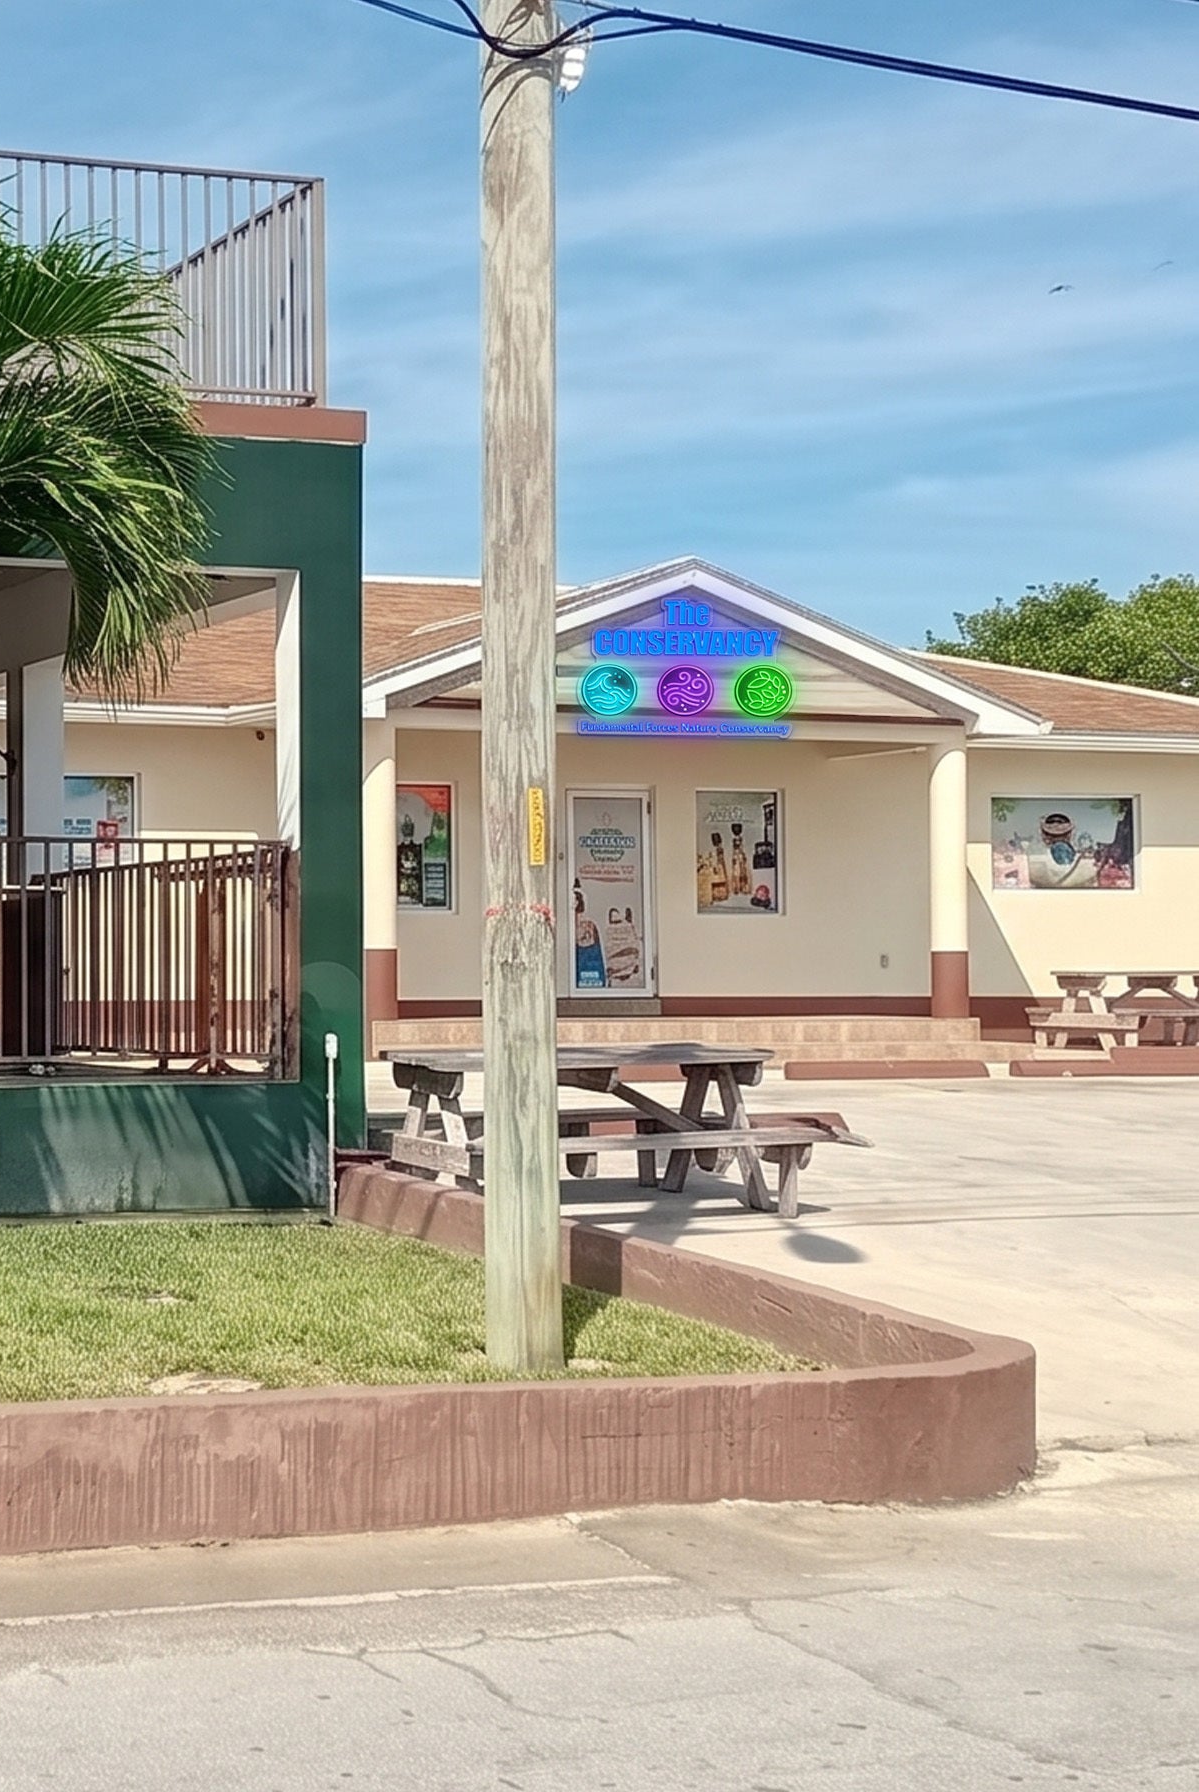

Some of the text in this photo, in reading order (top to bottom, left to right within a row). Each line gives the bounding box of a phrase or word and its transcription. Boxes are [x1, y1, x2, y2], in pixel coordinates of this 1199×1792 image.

[664, 599, 710, 626] The
[594, 629, 779, 657] CONSERVANCY
[581, 721, 790, 737] Fundamental Forces Nature Conservancy
